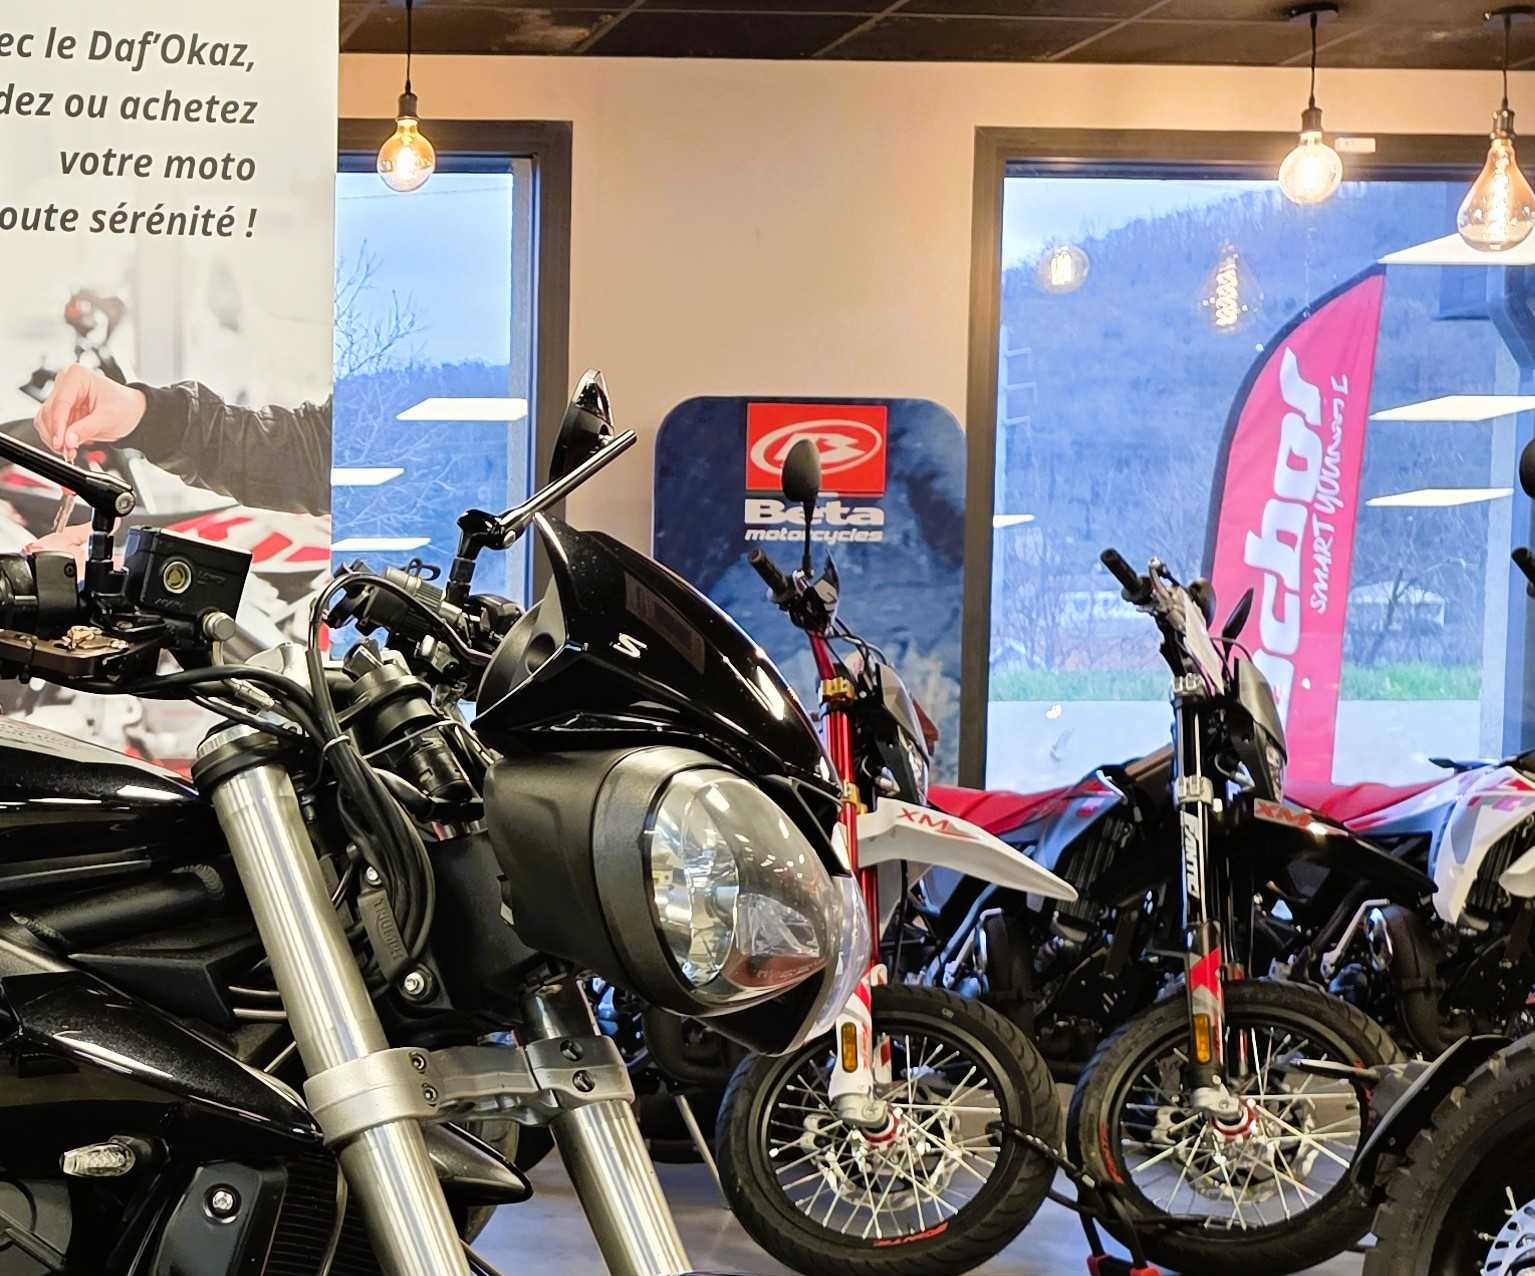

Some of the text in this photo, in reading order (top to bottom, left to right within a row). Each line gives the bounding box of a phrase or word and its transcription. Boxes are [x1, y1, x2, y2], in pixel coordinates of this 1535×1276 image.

[44, 27, 76, 61] le
[64, 92, 108, 120] ou
[119, 90, 259, 126] achetez
[59, 147, 257, 182] votre moto
[89, 199, 236, 239] sérénité
[744, 493, 885, 526] Beta
